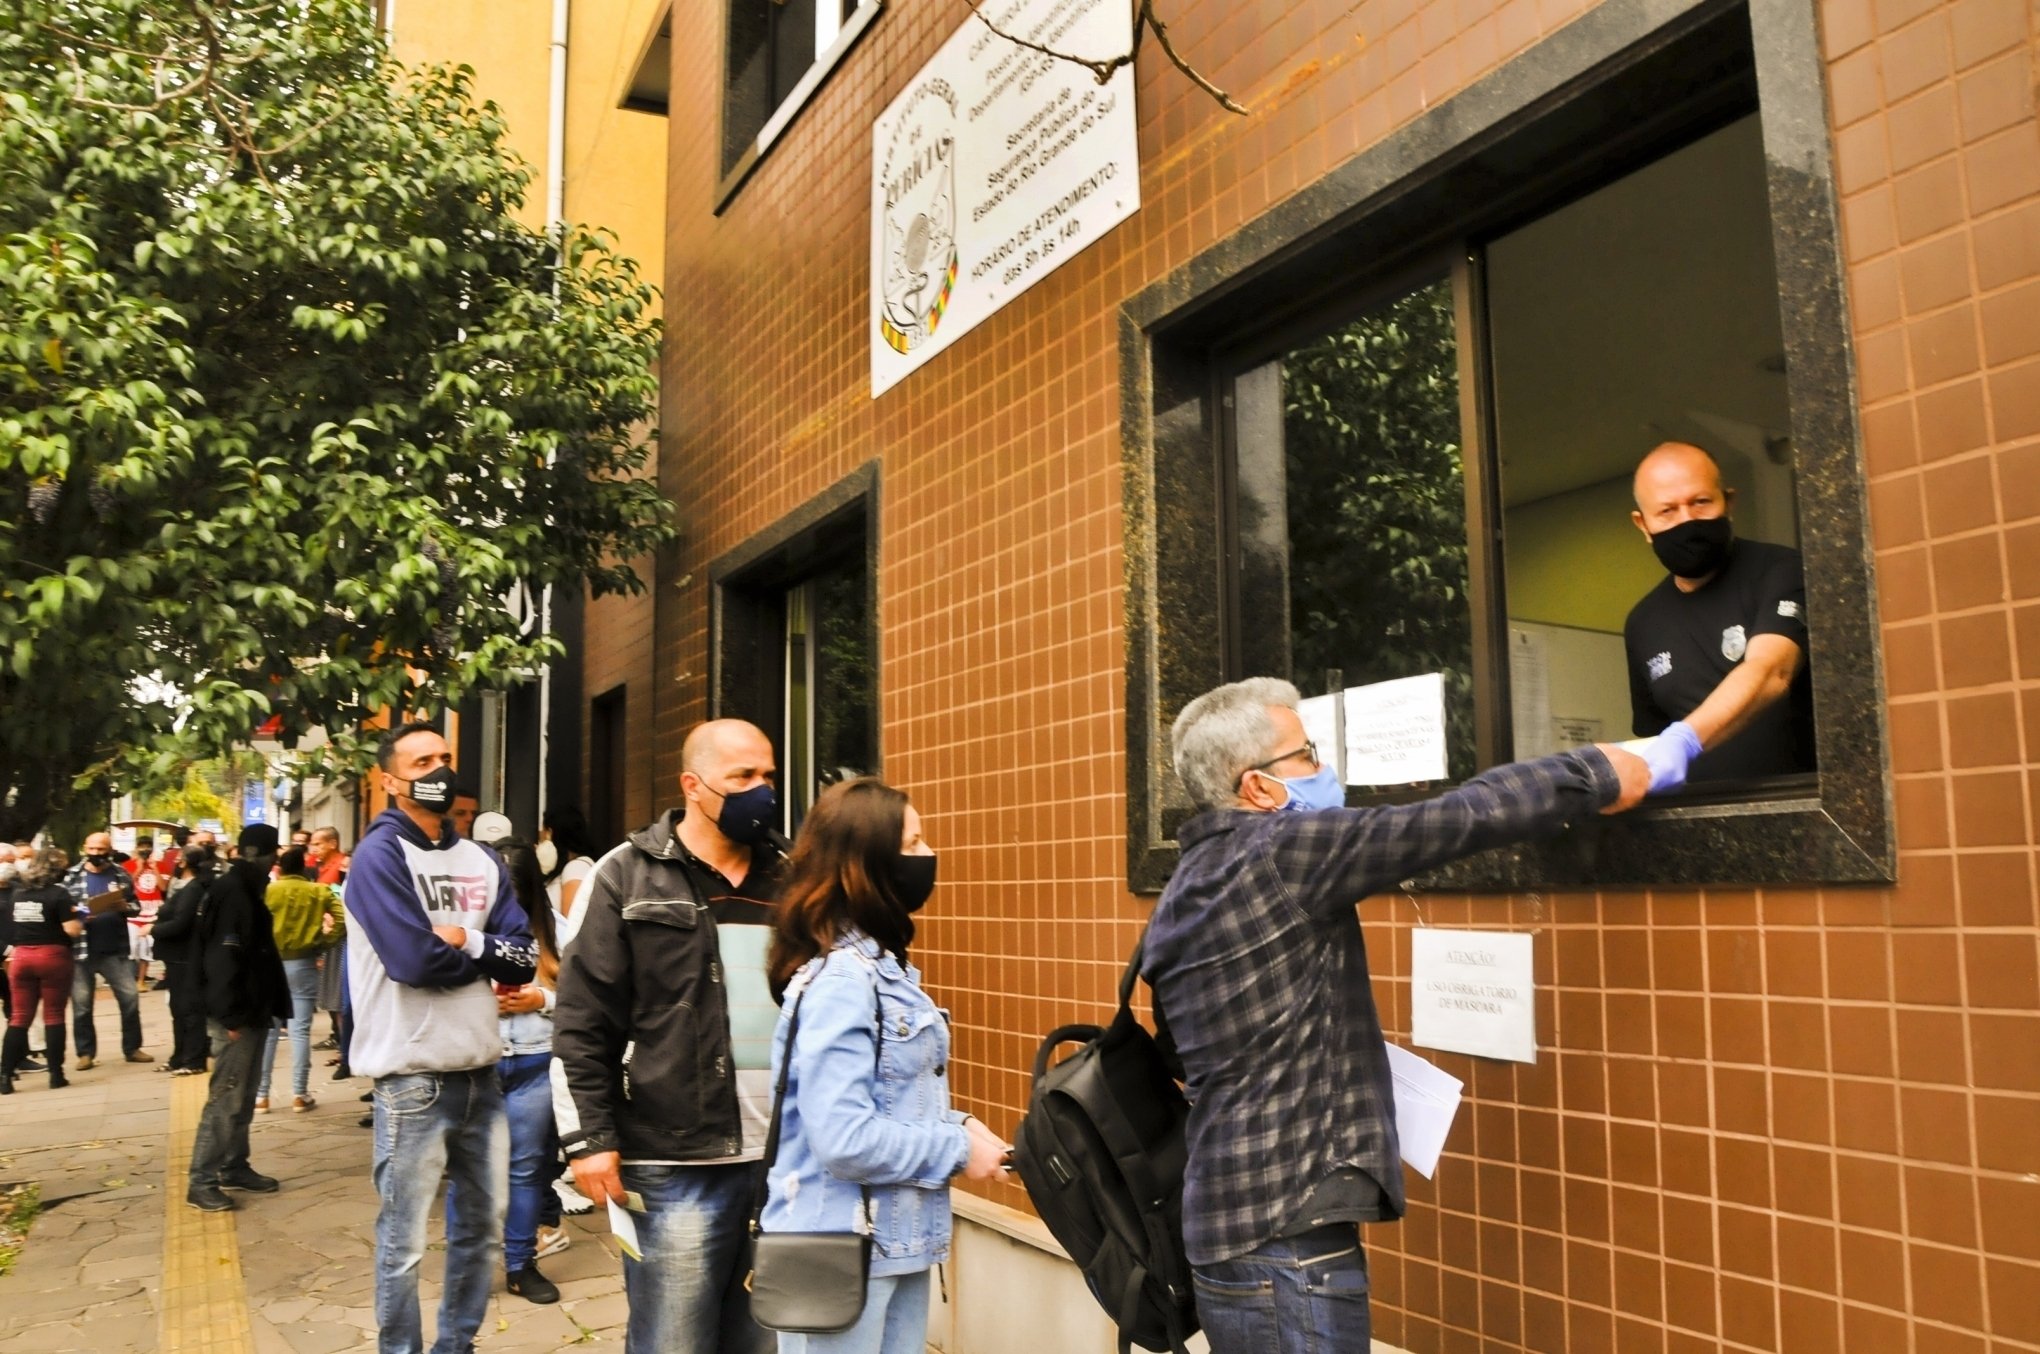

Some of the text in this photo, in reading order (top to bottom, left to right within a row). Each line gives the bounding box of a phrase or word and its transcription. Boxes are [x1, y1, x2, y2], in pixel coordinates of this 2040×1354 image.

[986, 138, 1038, 189] Segurança
[1080, 90, 1095, 110] do
[1006, 86, 1072, 151] Secretaria de
[972, 92, 1115, 223] Estado do Rio Grande do Sul
[1002, 262, 1022, 286] das
[1058, 217, 1080, 244] 14h
[1017, 224, 1032, 247] DE
[417, 873, 488, 912] VANS
[1439, 997, 1454, 1009] DE
